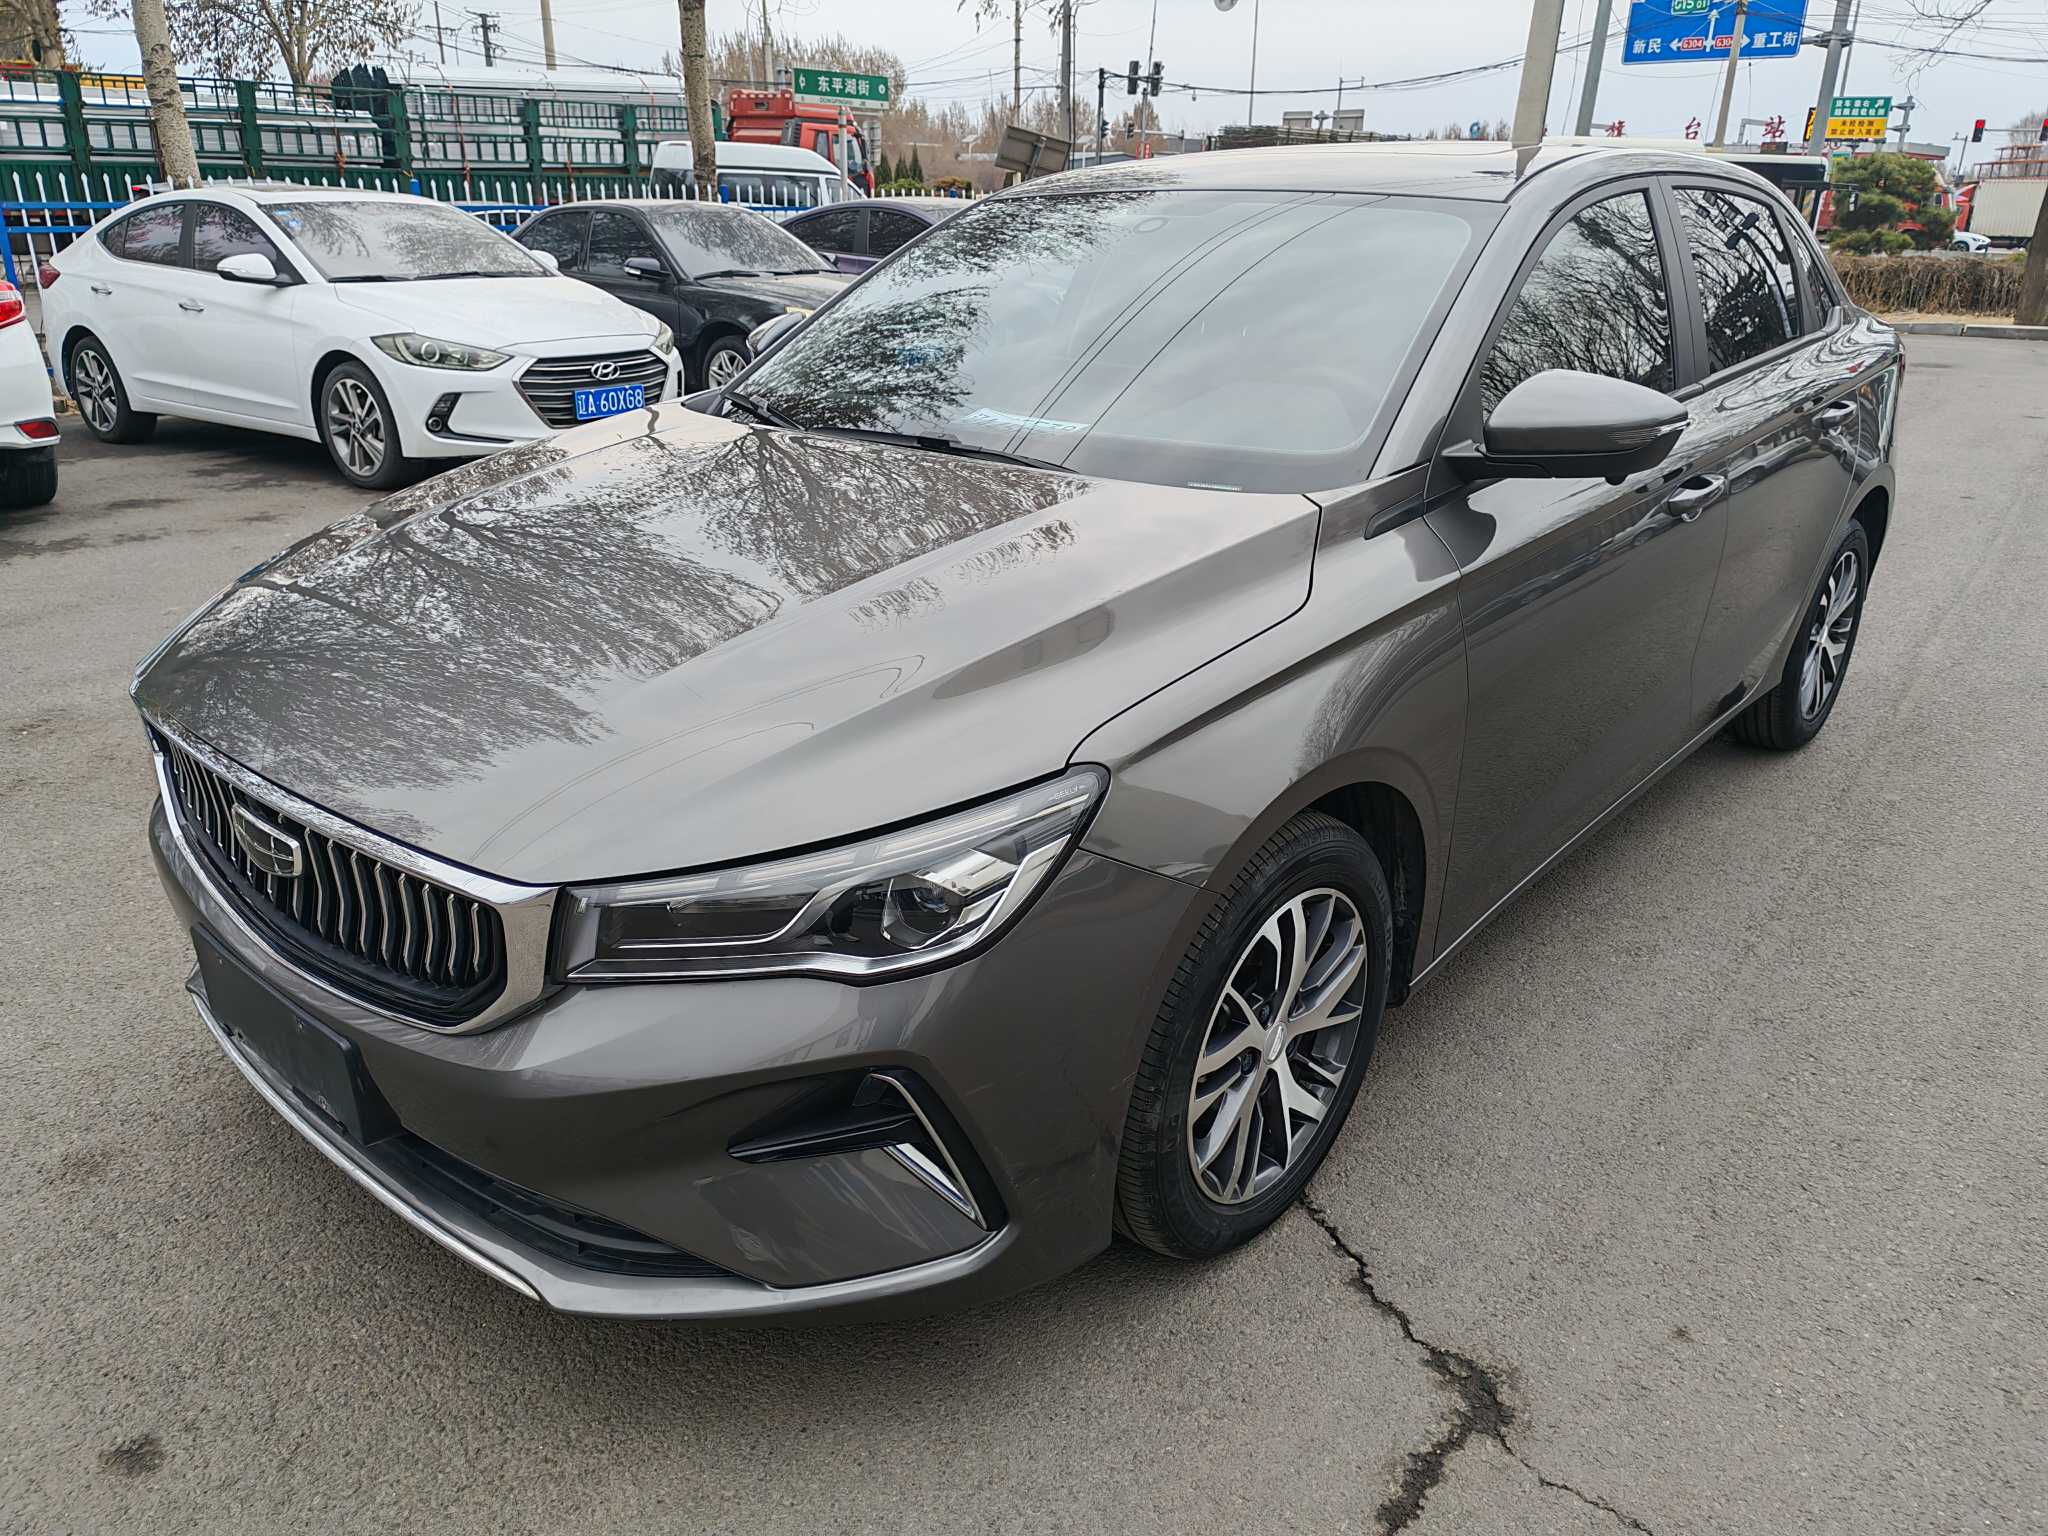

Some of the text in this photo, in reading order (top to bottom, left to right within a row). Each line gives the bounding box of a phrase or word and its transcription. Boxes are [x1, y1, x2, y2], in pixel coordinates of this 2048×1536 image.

[1632, 38, 1661, 54] 新民
[1683, 39, 1702, 48] G304
[1716, 37, 1734, 47] G30
[1752, 31, 1798, 48] 重工街
[817, 75, 869, 96] 东平湖街
